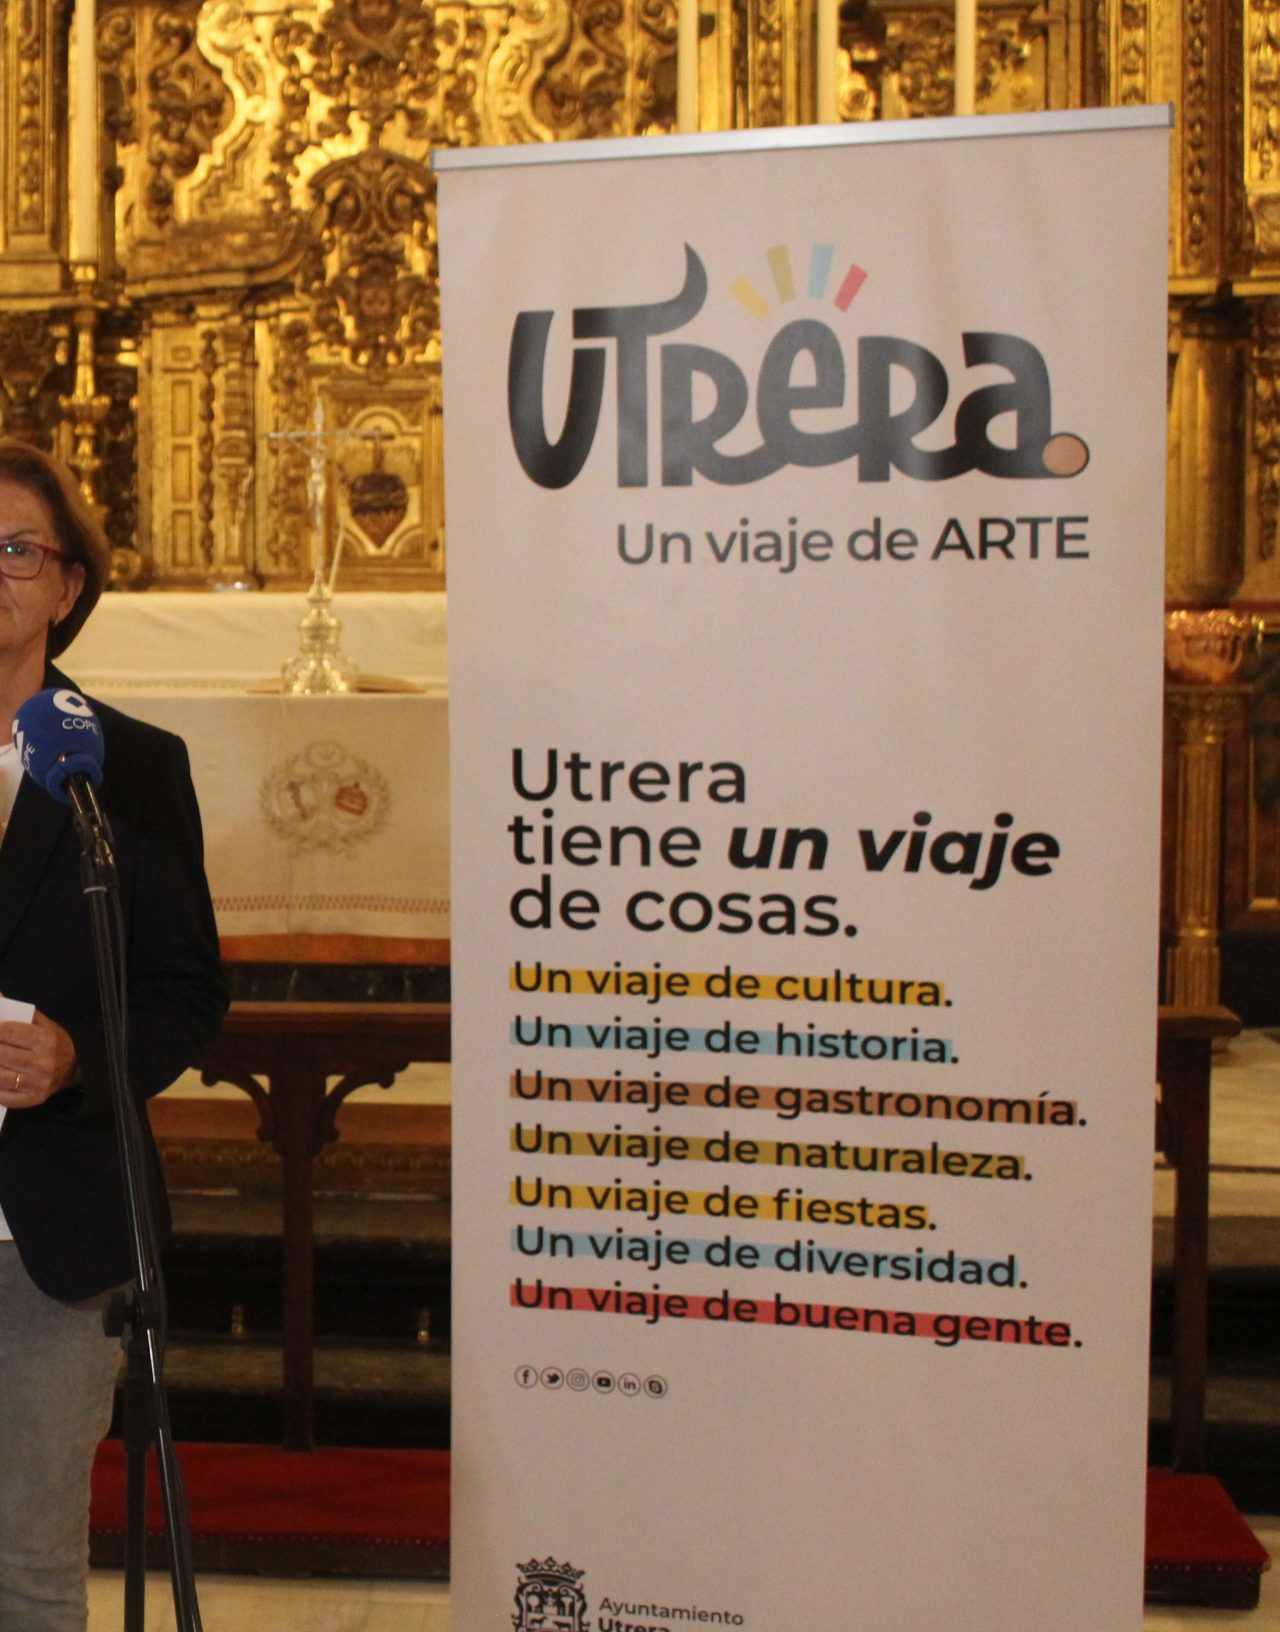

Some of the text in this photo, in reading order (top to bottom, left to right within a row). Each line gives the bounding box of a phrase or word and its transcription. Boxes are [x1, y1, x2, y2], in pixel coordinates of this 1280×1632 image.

[618, 515, 1089, 573] Un viaje de ARTE
[62, 718, 98, 735] COPE
[512, 748, 745, 803] Utrera
[507, 808, 1060, 890] tiene un viaje
[510, 873, 857, 937] de cosas.
[515, 960, 952, 1007] Un viaje de cultura.
[515, 1016, 959, 1064] Un viaje de historia.
[515, 1069, 1086, 1126] Un viaje de gastronomía.
[515, 1122, 1032, 1181] Un viaje de naturaleza.
[515, 1175, 936, 1230] Un viaje de fiestas.
[516, 1225, 1027, 1288] Un viaje de diversidad.
[515, 1277, 1082, 1348] Un viaje de buena gente.
[598, 1597, 744, 1625] Ayuntamiento
